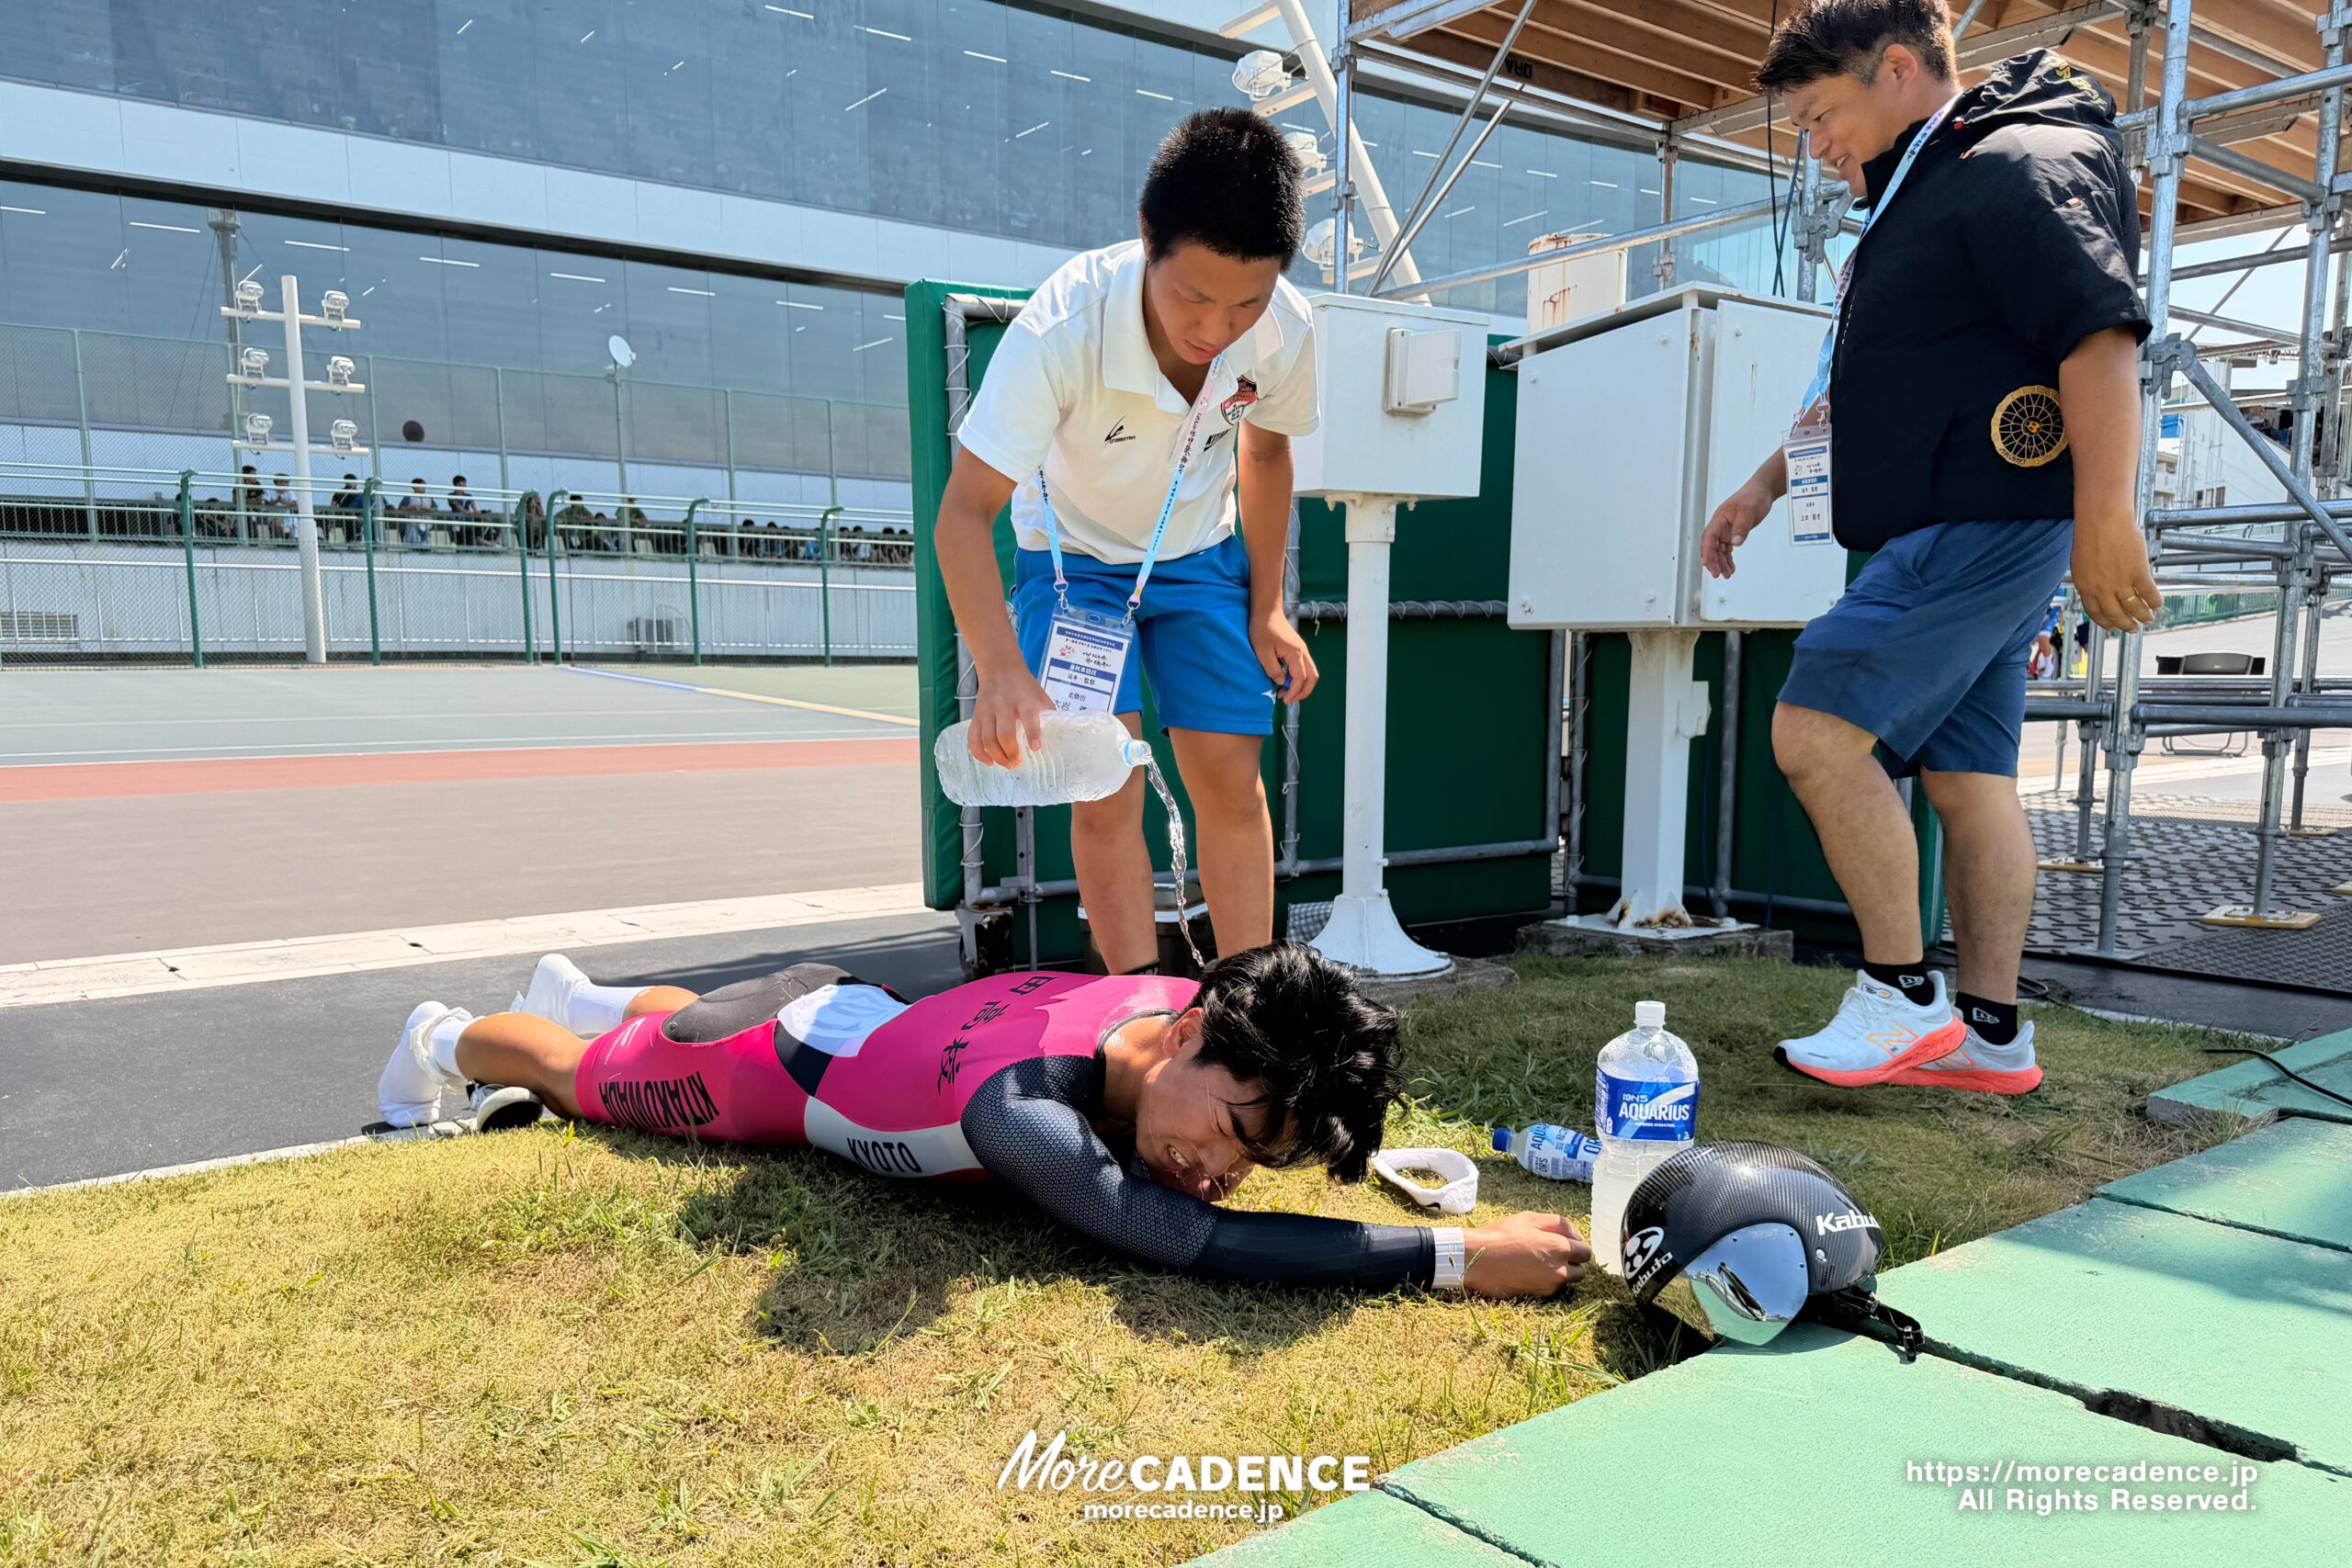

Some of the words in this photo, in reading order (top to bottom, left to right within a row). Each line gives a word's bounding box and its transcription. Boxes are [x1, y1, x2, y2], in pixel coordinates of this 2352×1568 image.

[598, 1071, 720, 1130] KITAKUWADA
[1618, 1101, 1690, 1121] AQUARIUS
[846, 1137, 922, 1173] KYOTO
[1583, 1138, 1602, 1156] OR
[1631, 1251, 1673, 1298] Kabuto
